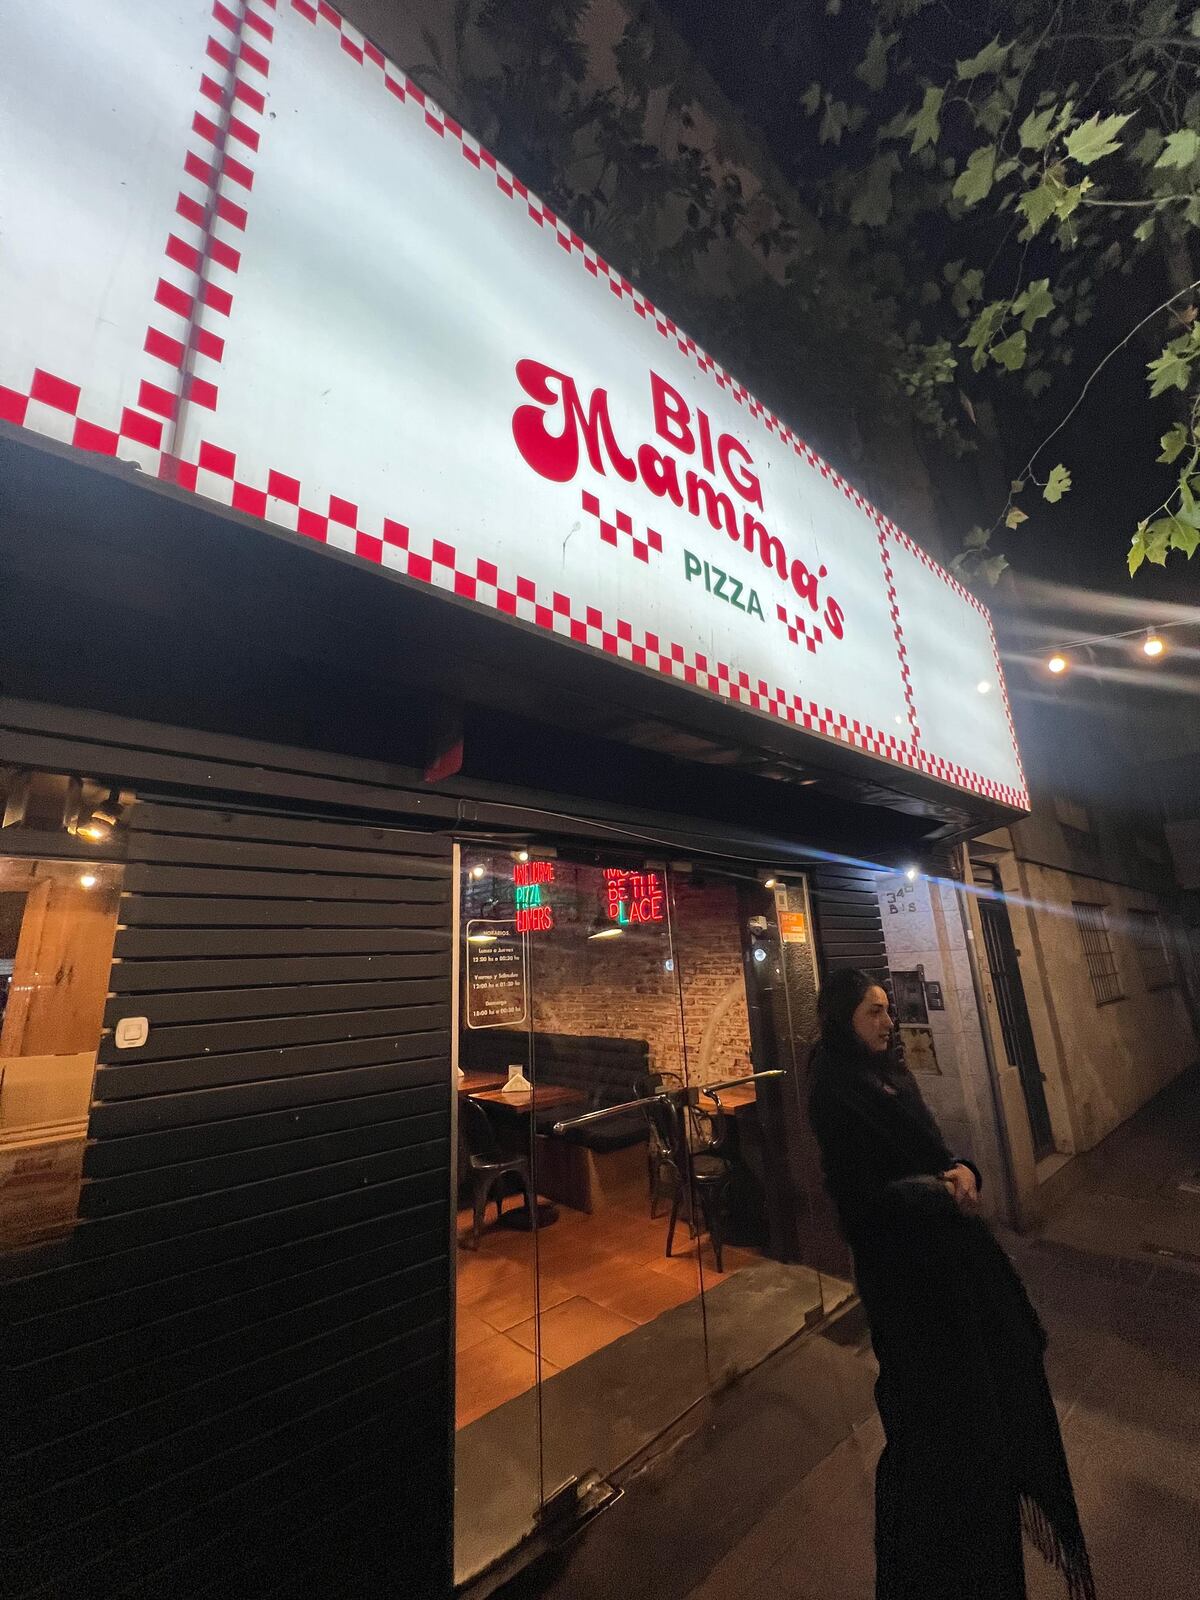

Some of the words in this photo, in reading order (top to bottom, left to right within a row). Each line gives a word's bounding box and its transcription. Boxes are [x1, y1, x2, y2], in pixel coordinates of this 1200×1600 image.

[649, 368, 764, 513] BIG
[511, 358, 844, 640] Mamma's
[683, 548, 765, 622] PIZZA
[513, 861, 554, 886] WELCOME
[516, 884, 541, 910] PIZZA
[516, 905, 552, 932] LOVERS
